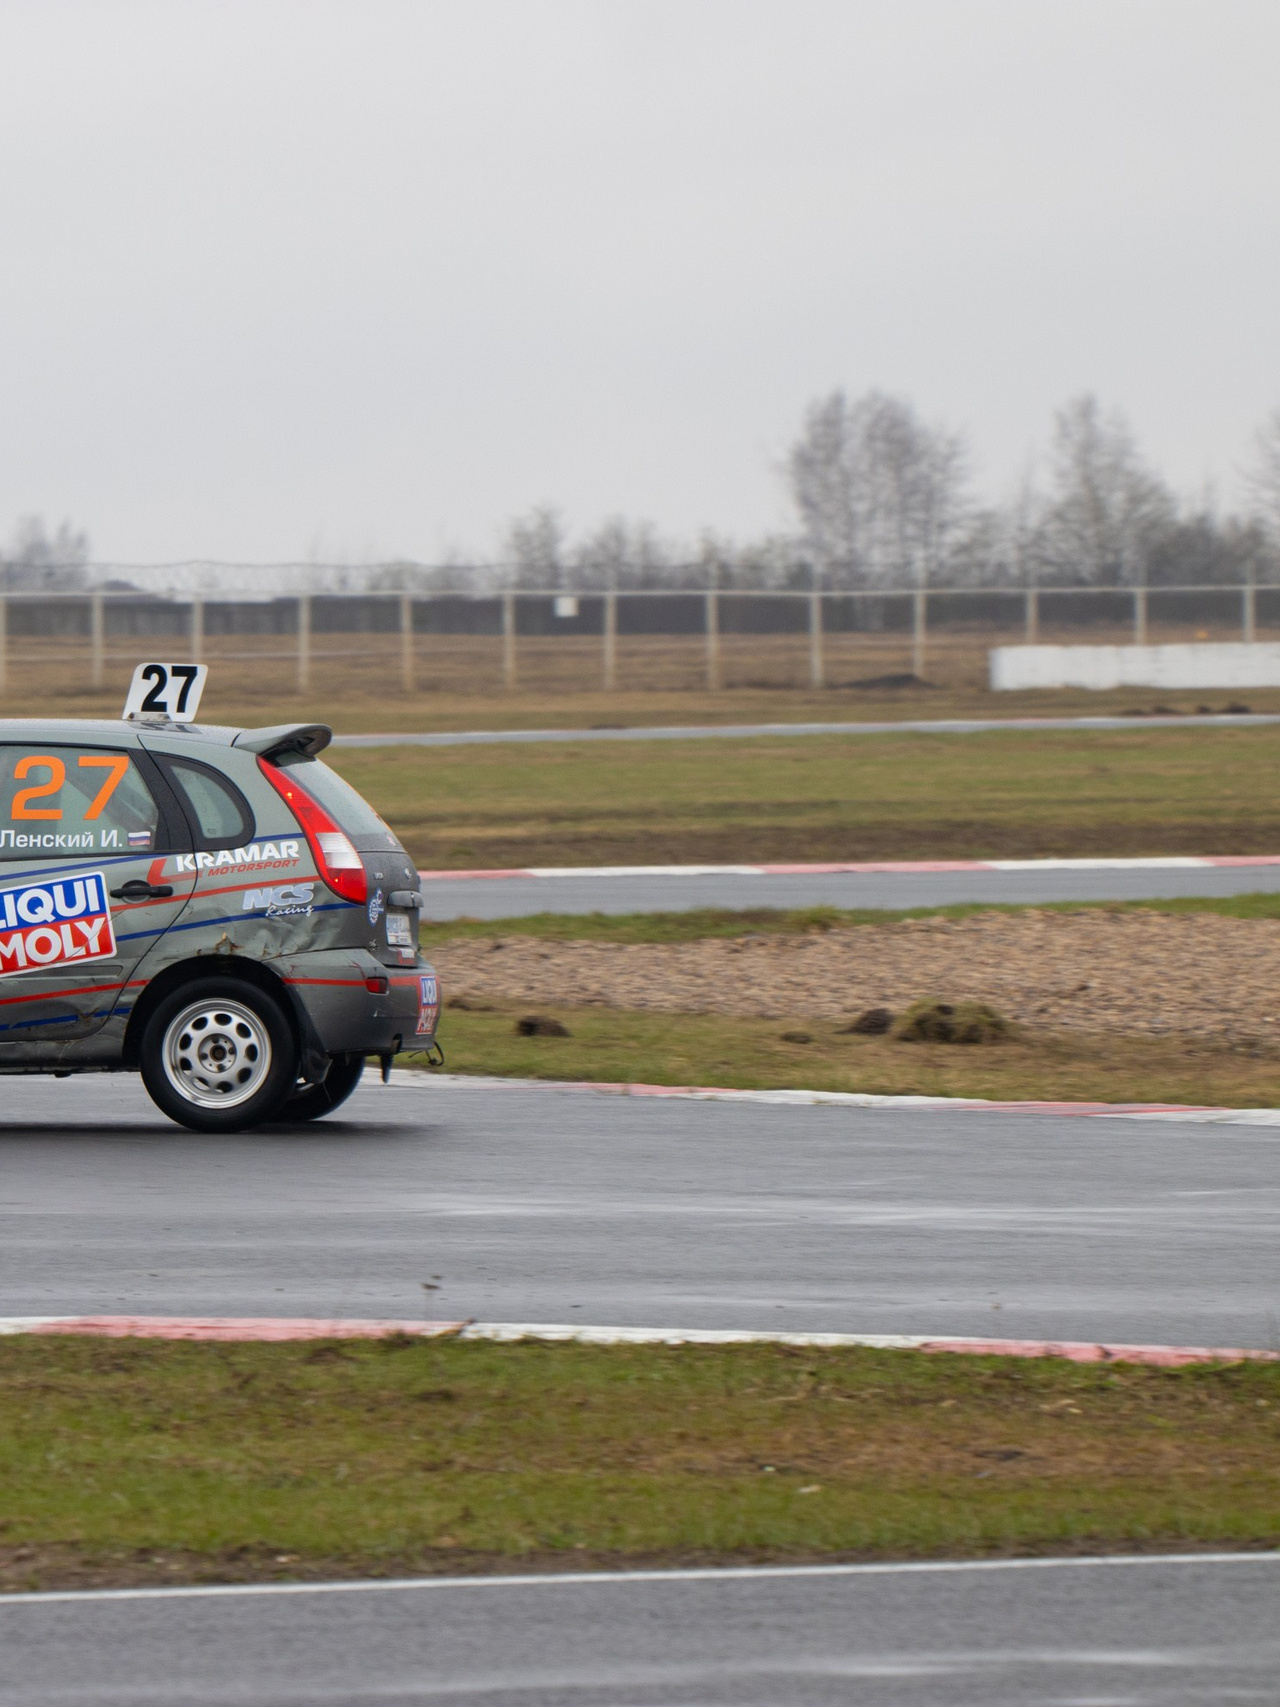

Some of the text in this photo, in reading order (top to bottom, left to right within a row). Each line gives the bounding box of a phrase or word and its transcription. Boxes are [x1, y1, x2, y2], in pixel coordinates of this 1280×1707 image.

[141, 664, 198, 713] 27
[11, 755, 130, 820] 27
[101, 829, 123, 848] И.
[176, 840, 300, 872] KRAMAR
[207, 858, 300, 877] MOTORSPORT
[242, 882, 315, 910] NCS
[265, 903, 315, 918] Racing
